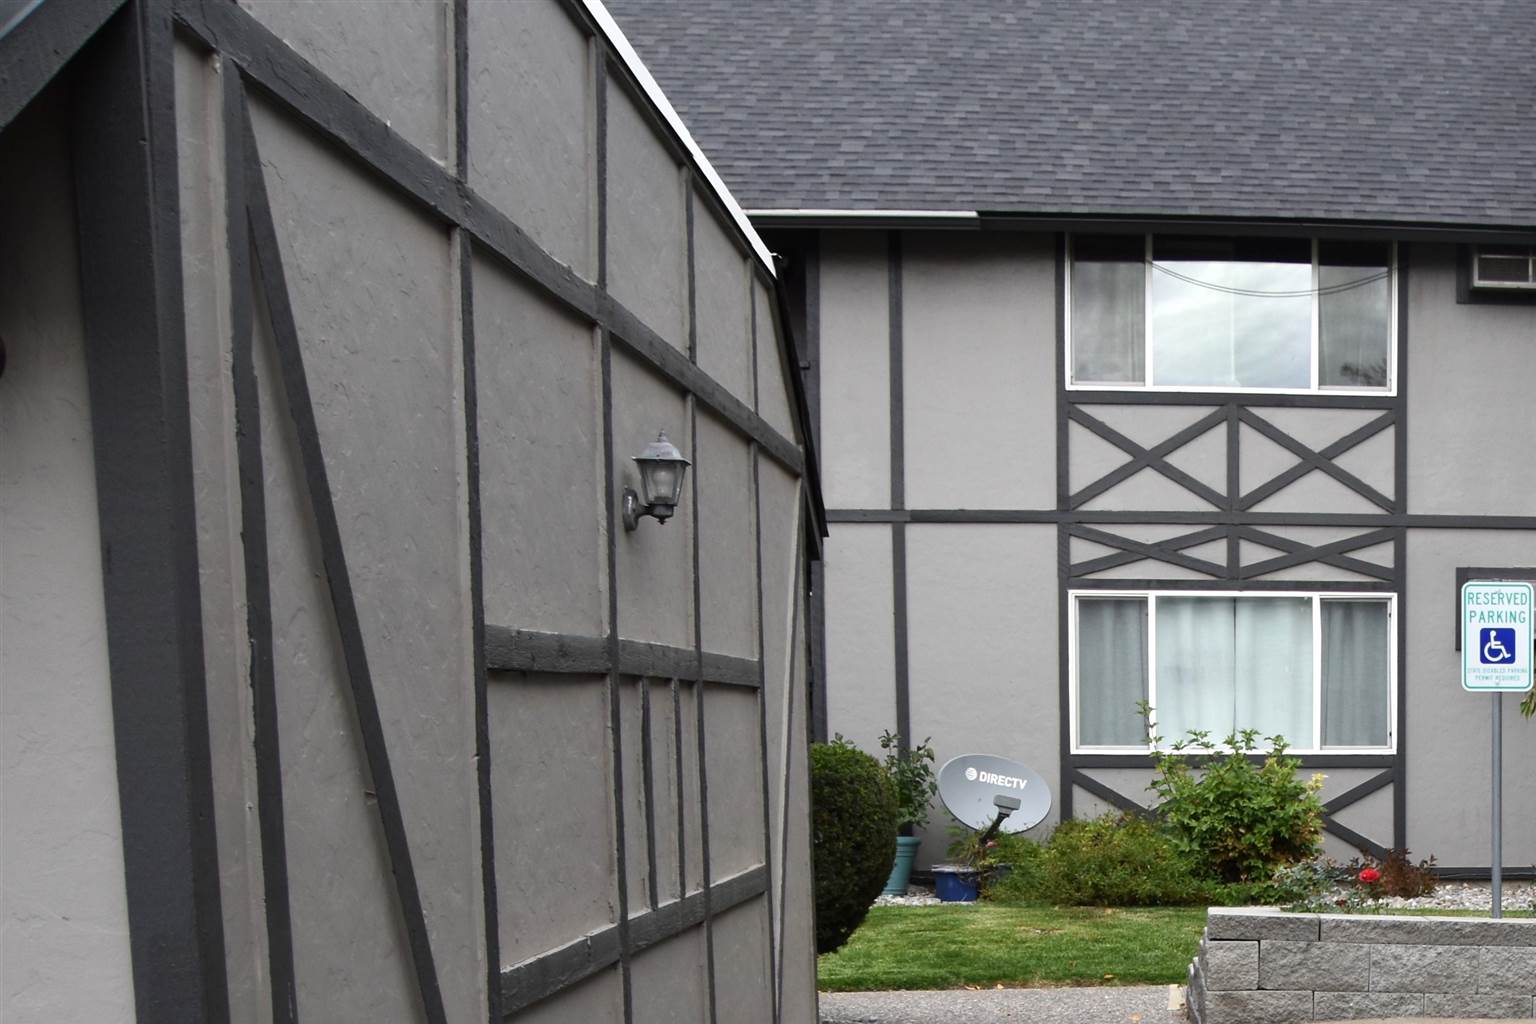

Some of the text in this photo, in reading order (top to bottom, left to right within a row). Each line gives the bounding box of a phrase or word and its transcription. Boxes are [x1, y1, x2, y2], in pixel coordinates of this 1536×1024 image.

[1467, 592, 1528, 606] RESERVED
[1469, 610, 1526, 624] PARKING
[979, 771, 1027, 790] DIRECTV
